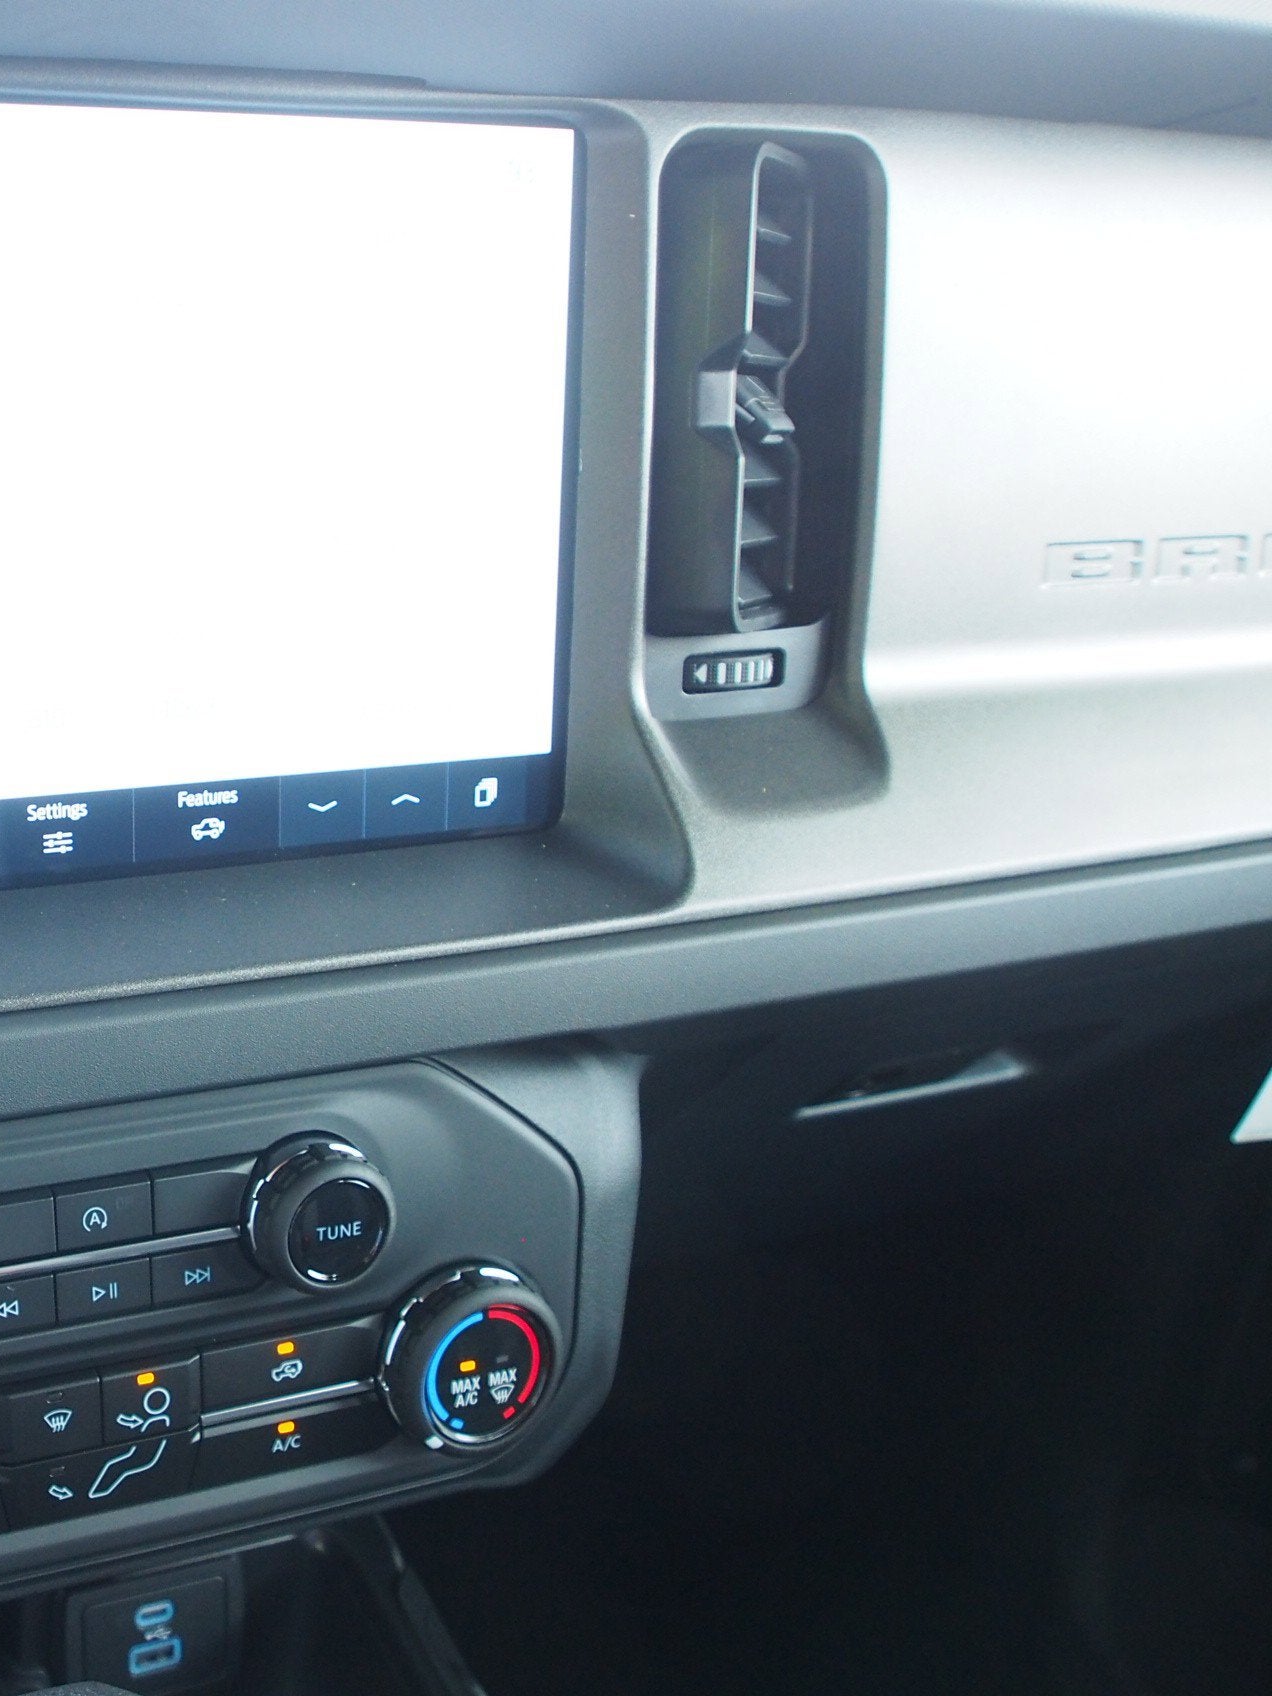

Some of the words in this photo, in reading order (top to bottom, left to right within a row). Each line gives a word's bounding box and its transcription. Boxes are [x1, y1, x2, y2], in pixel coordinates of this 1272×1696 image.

[1040, 533, 1272, 588] BR
[177, 788, 238, 809] Features
[27, 801, 88, 823] Settings
[316, 1220, 362, 1241] TUNE
[451, 1376, 481, 1395] MAX
[487, 1367, 517, 1386] MAX
[455, 1391, 479, 1409] A/C
[271, 1434, 301, 1454] A/C
